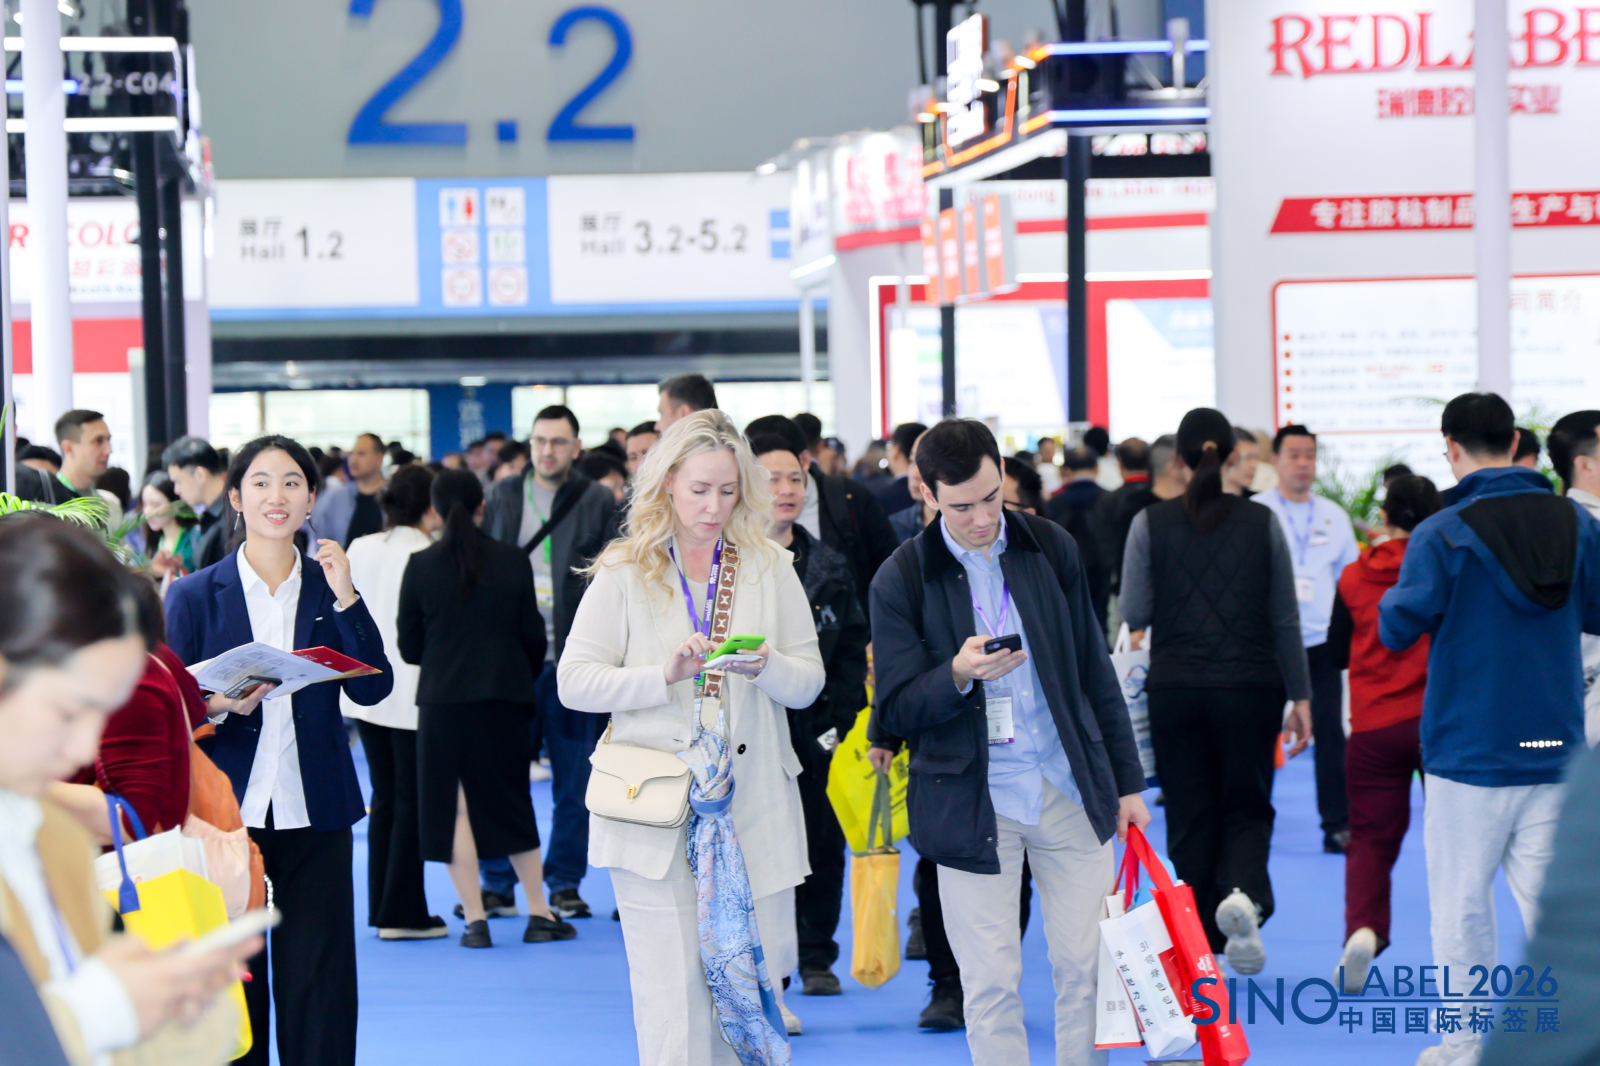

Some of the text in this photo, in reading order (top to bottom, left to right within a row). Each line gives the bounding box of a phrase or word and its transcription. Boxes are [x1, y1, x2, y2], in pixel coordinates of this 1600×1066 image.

[1267, 8, 1600, 79] REDLBE
[346, 0, 635, 146] 2.2
[1378, 85, 1561, 118] 瑞德胶实业
[241, 226, 343, 260] Hall 1.2
[581, 219, 748, 256] Hall 3.2-5.2
